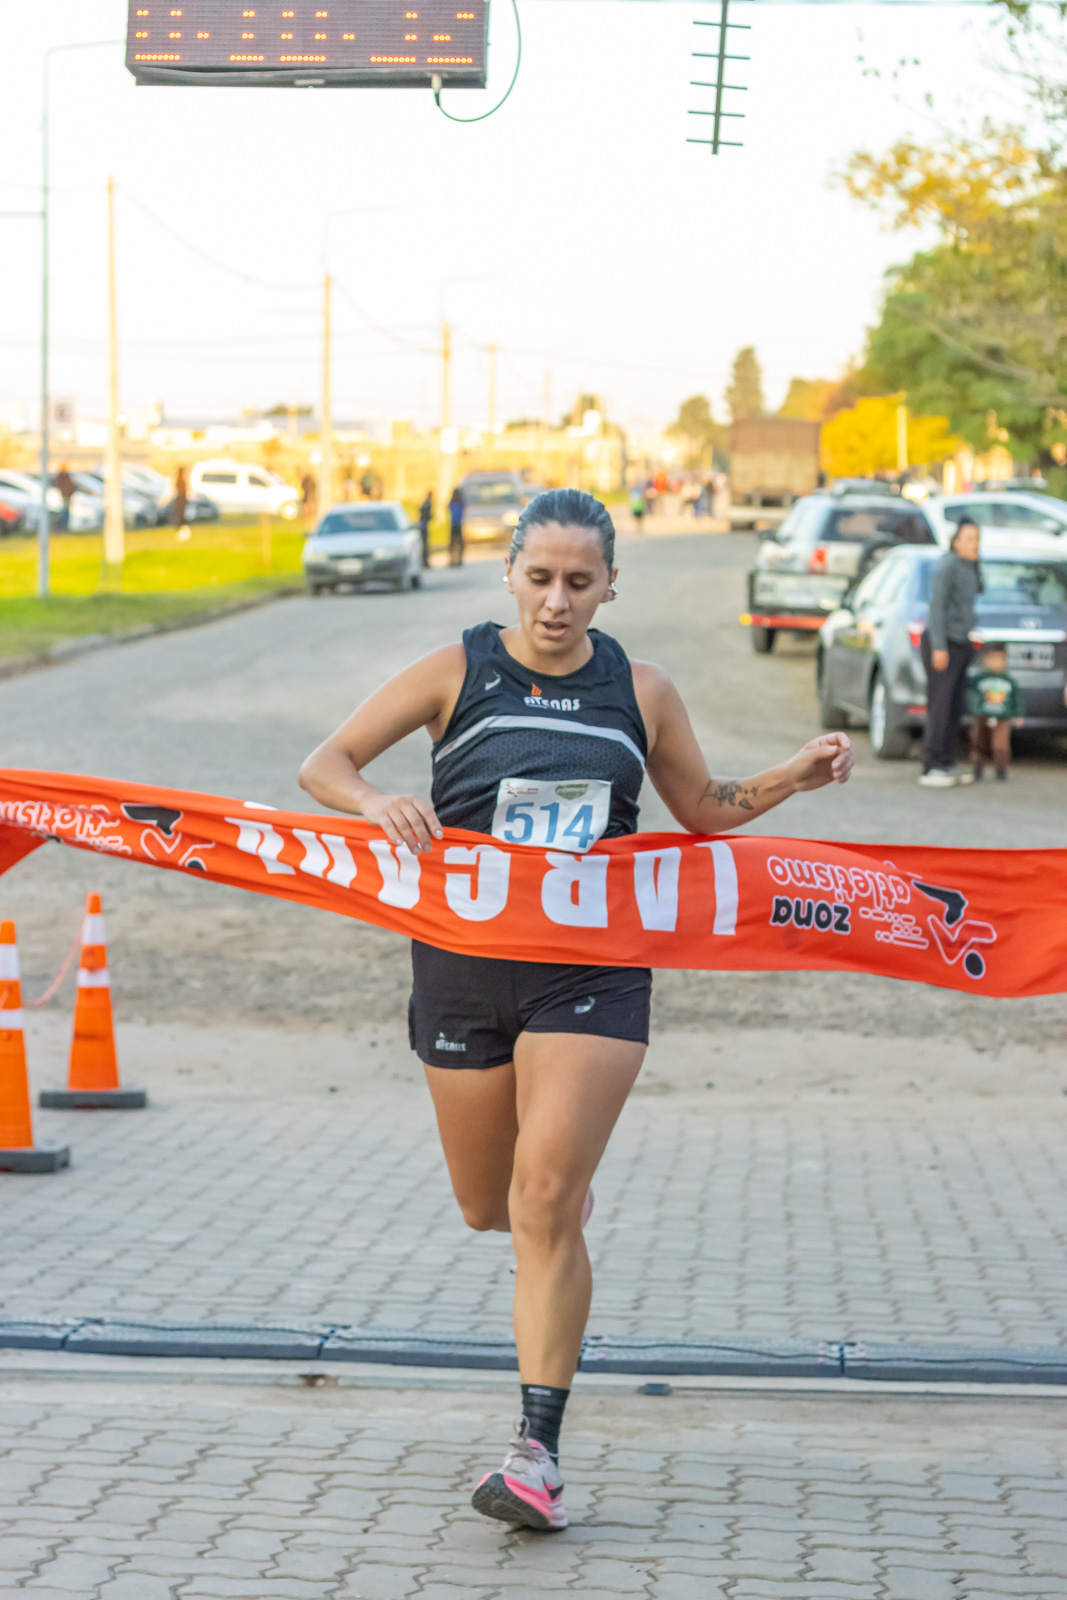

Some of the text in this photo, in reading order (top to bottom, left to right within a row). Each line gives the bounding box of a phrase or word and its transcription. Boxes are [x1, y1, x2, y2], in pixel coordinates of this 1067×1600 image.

[503, 801, 594, 849] 514
[767, 856, 911, 910] atletismo
[769, 895, 851, 935] zona
